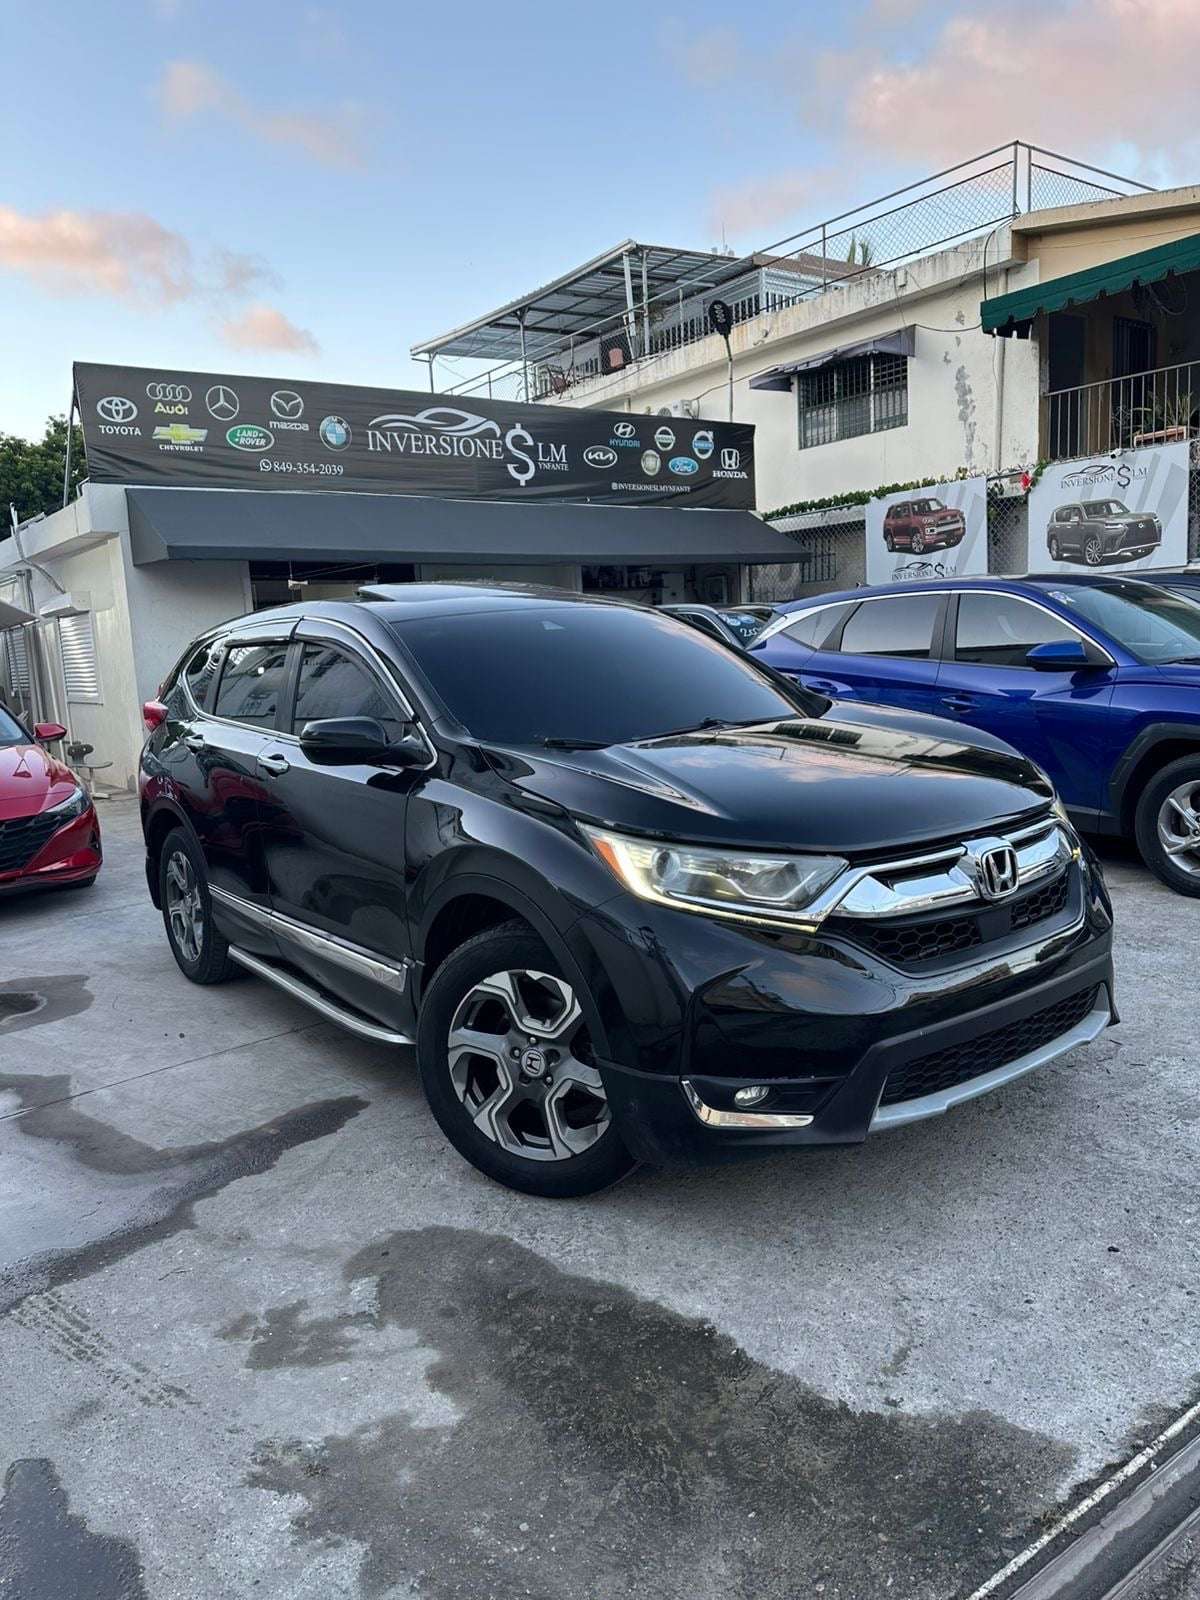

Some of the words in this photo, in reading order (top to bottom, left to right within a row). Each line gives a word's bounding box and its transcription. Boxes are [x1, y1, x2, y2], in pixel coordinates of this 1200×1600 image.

[154, 402, 189, 415] Audi
[99, 425, 141, 436] TOYOTA
[236, 429, 259, 437] LAND
[239, 438, 266, 446] ROVER
[609, 438, 640, 447] HYUNDAI
[159, 444, 204, 452] CHEVROLET
[538, 442, 568, 463] LM
[273, 461, 344, 475] 849-354-2039
[538, 461, 569, 471] YNFANTE
[712, 470, 748, 478] HONDA
